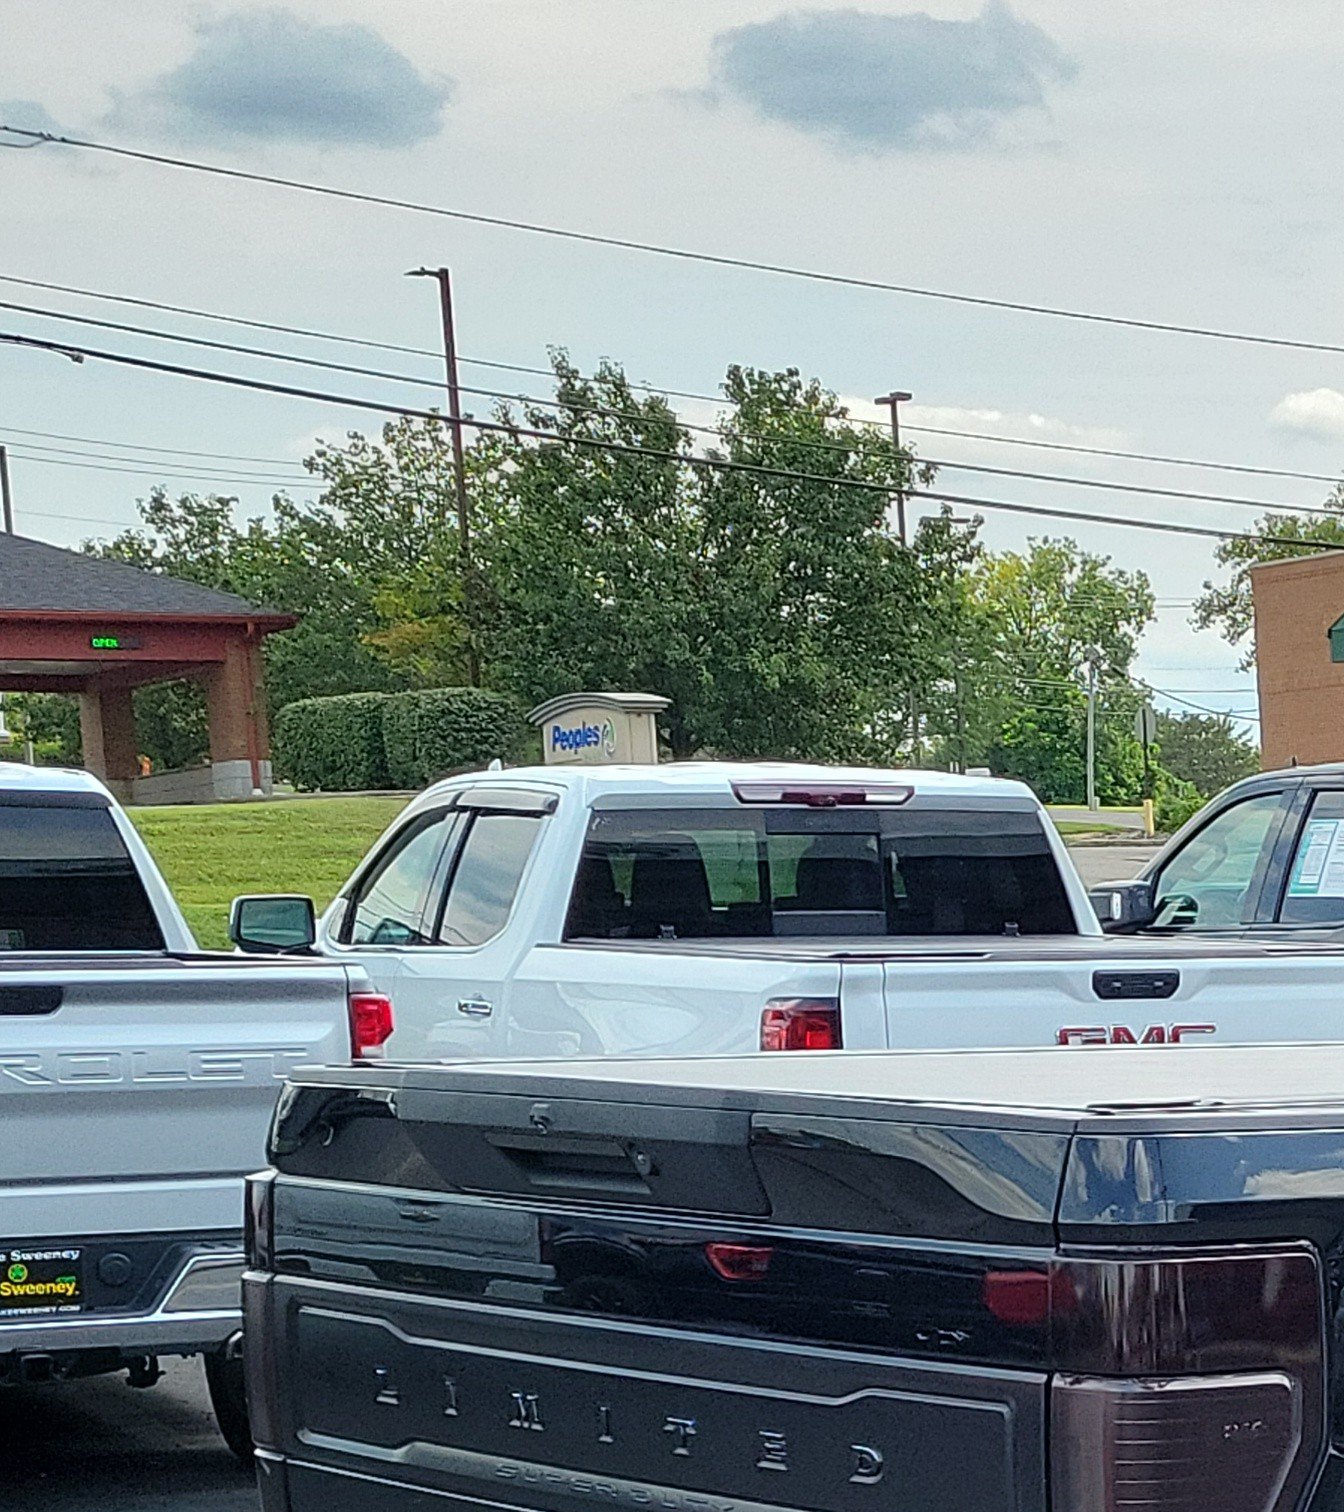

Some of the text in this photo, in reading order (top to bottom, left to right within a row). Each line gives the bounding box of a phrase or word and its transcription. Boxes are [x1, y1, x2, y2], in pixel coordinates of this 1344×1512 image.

[552, 721, 600, 755] Peoples
[10, 1249, 81, 1262] Sweeney
[374, 1365, 884, 1486] LIMITED
[494, 1464, 618, 1499] SUPER
